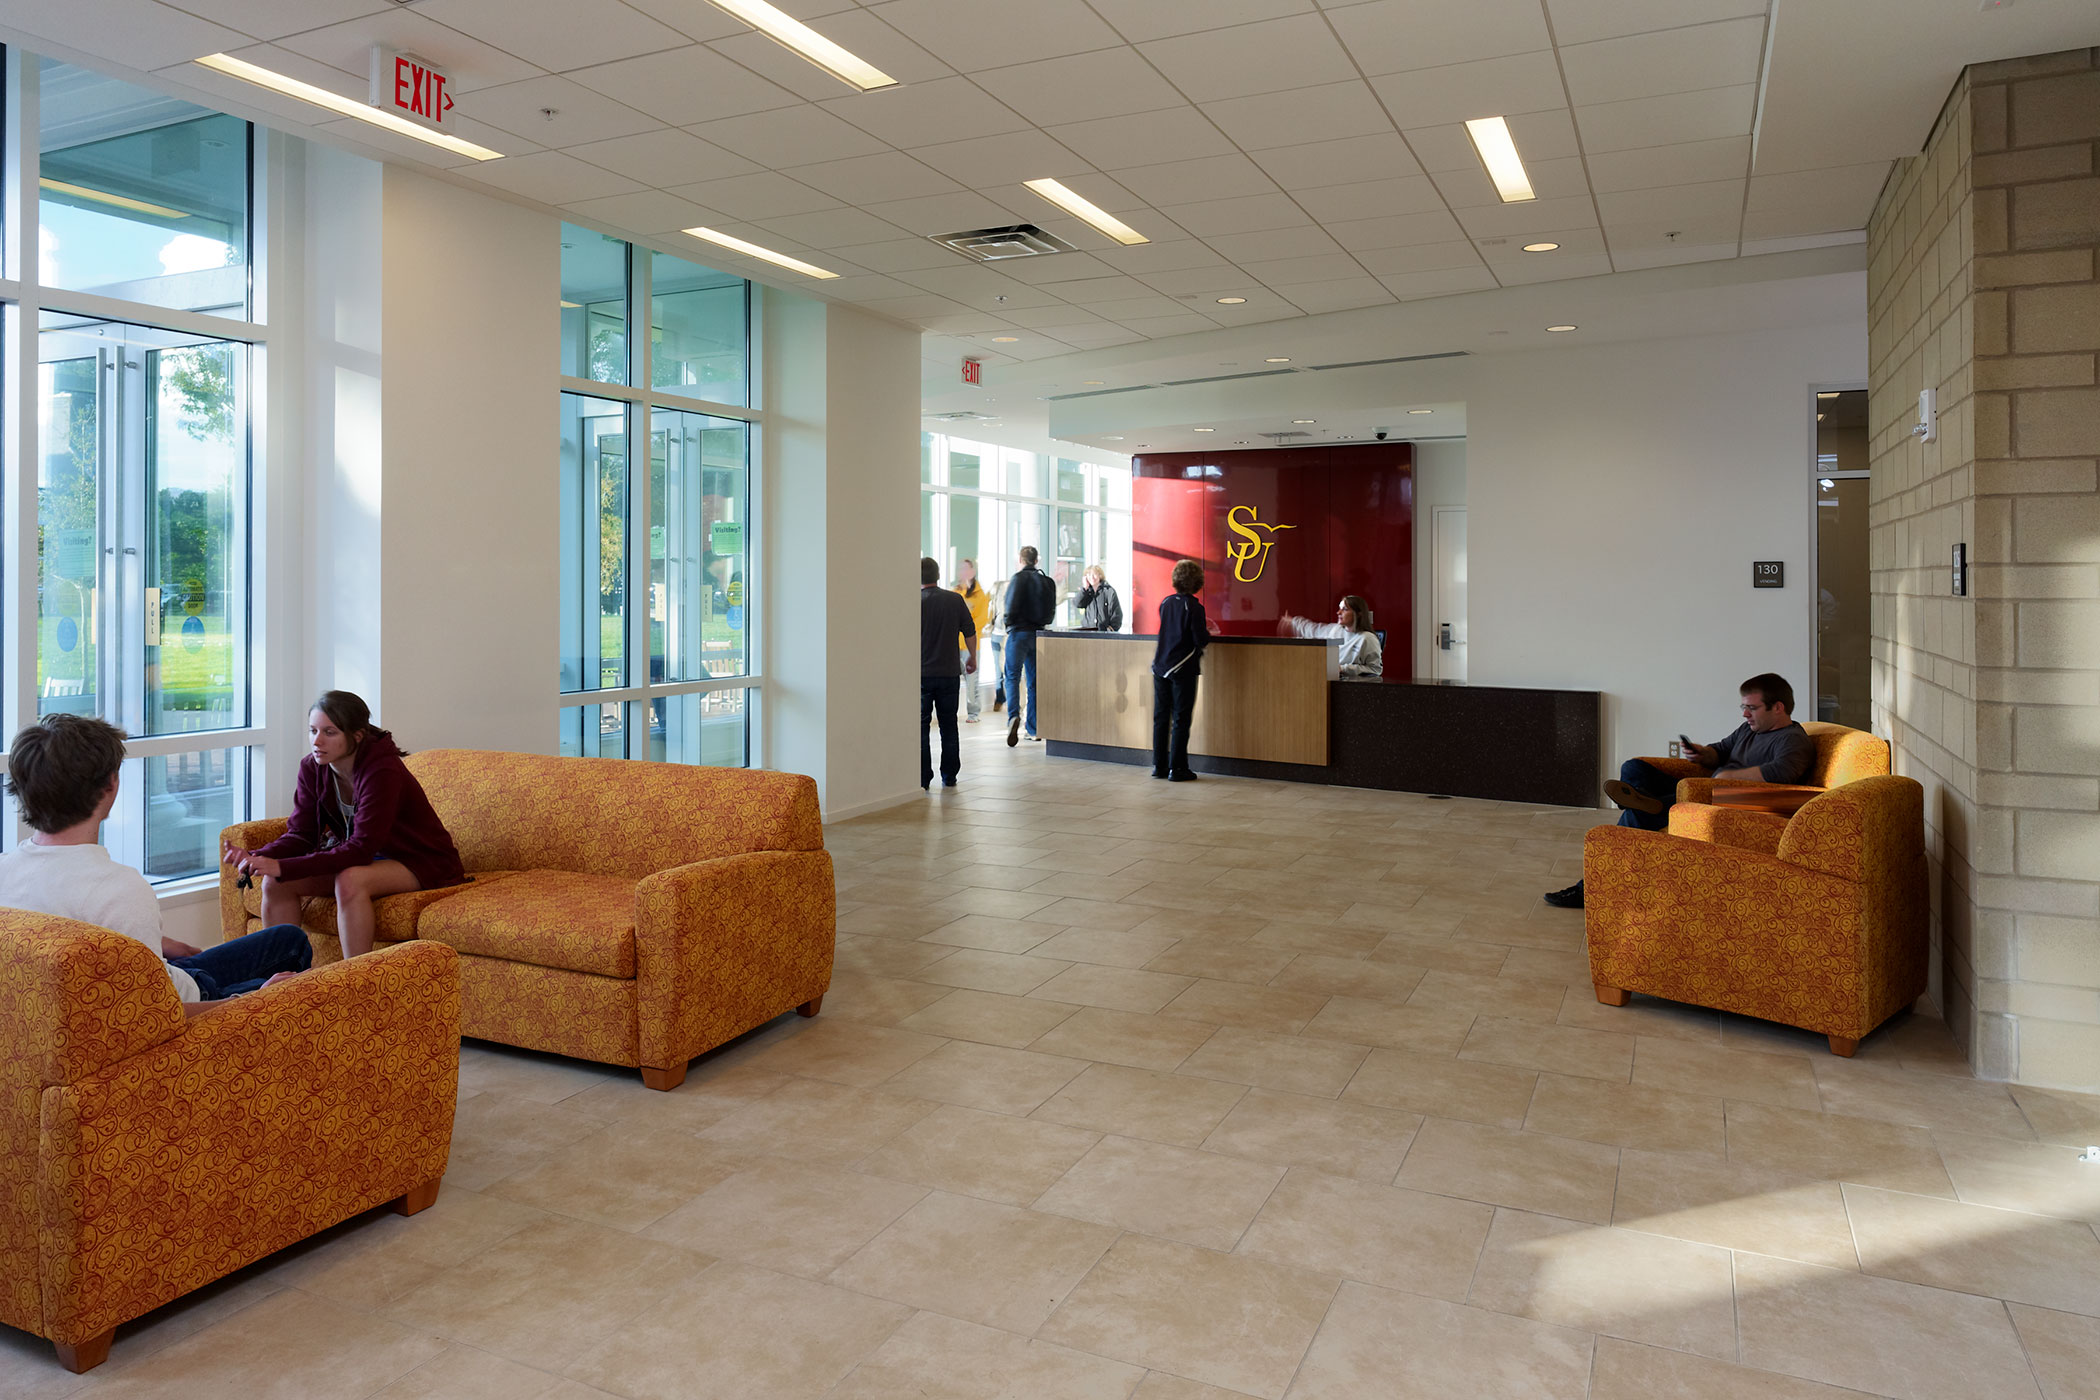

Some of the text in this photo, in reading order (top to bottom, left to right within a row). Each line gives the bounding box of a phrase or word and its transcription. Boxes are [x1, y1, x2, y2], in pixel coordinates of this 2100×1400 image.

[395, 56, 446, 123] EXIT
[965, 360, 980, 385] EXIT
[1758, 564, 1779, 575] 130
